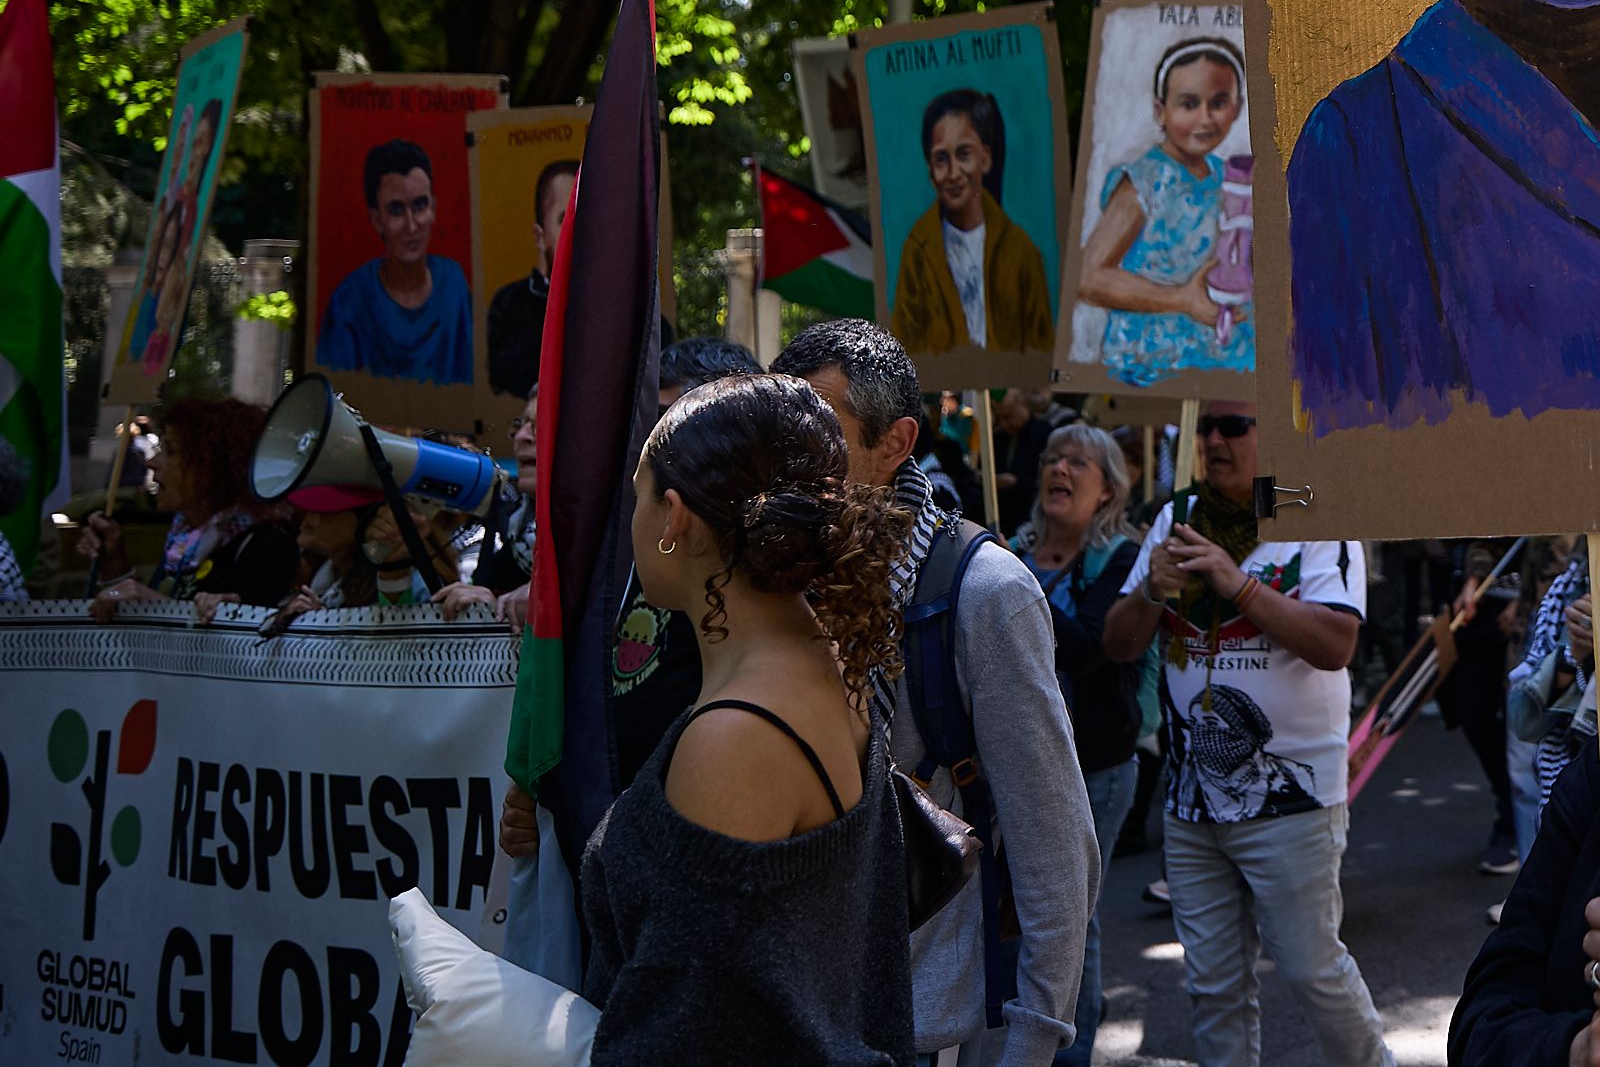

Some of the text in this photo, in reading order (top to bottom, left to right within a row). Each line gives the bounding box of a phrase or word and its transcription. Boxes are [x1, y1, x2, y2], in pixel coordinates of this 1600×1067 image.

[884, 29, 1023, 76] AMINA AL MUFTI
[168, 756, 496, 911] RESPUESTA
[37, 949, 136, 999] GLOBAL
[41, 987, 127, 1035] SUMUD
[57, 1030, 101, 1064] Spain
